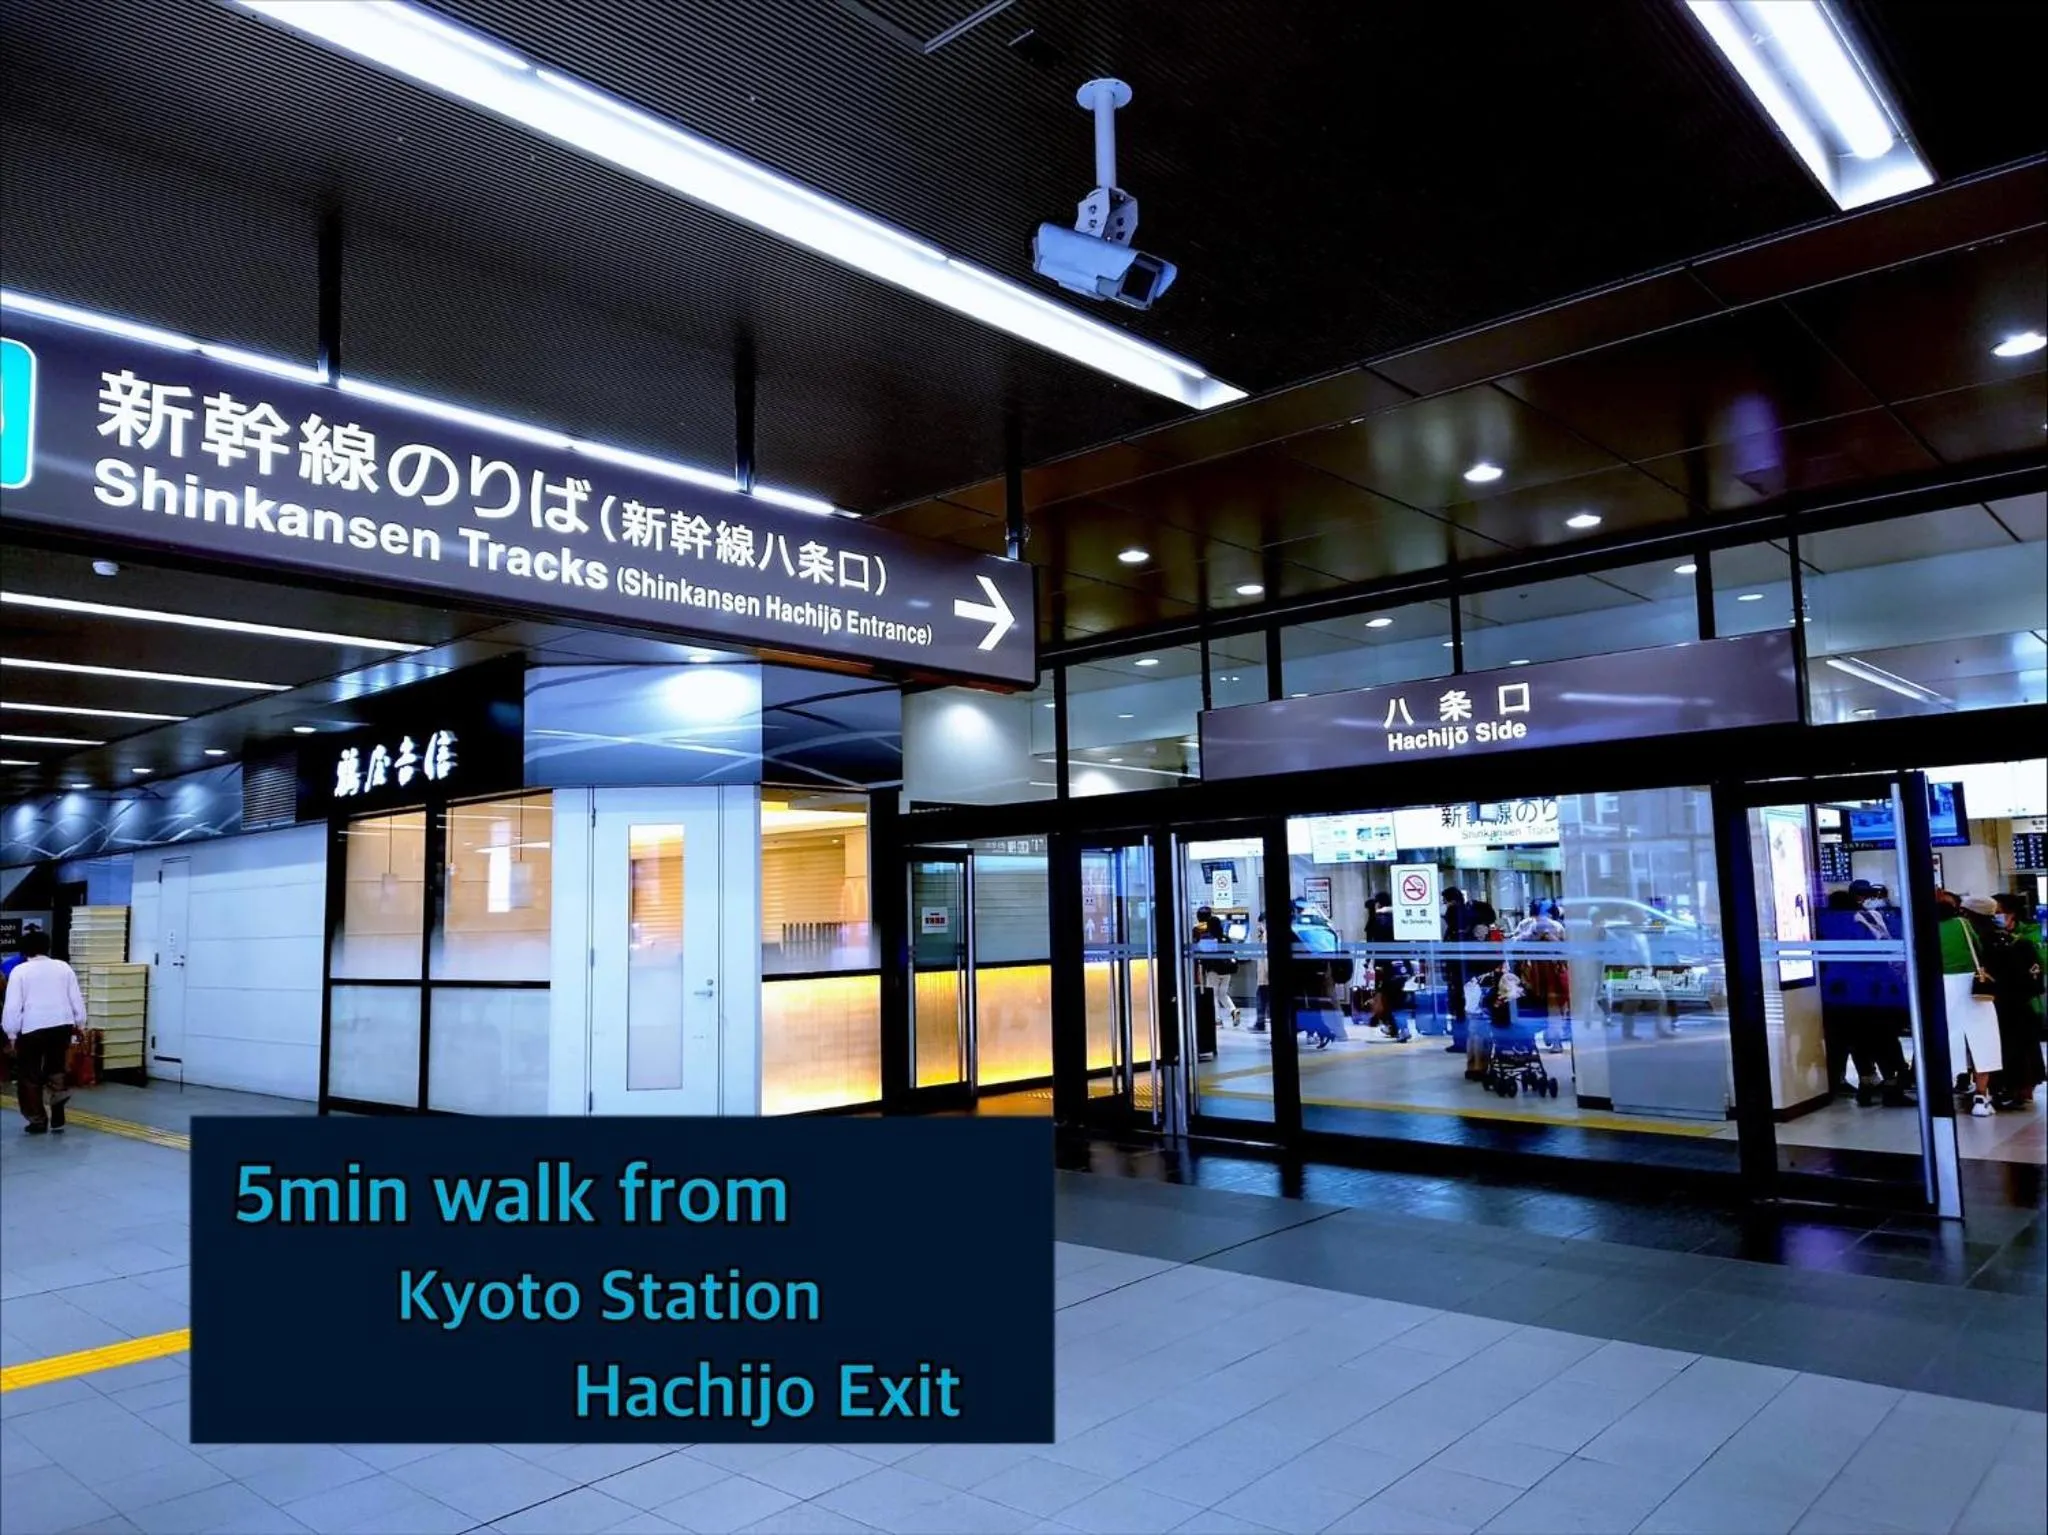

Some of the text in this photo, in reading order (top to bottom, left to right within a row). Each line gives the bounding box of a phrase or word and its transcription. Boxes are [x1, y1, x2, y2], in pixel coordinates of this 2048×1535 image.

[97, 369, 592, 533] 新幹線のりば
[93, 458, 442, 561] Shinkansen
[458, 528, 609, 590] Tracks
[616, 566, 760, 617] (Shinkansen
[846, 609, 932, 646] Entrance)
[1383, 682, 1530, 729] 八条口
[1475, 719, 1527, 743] Side
